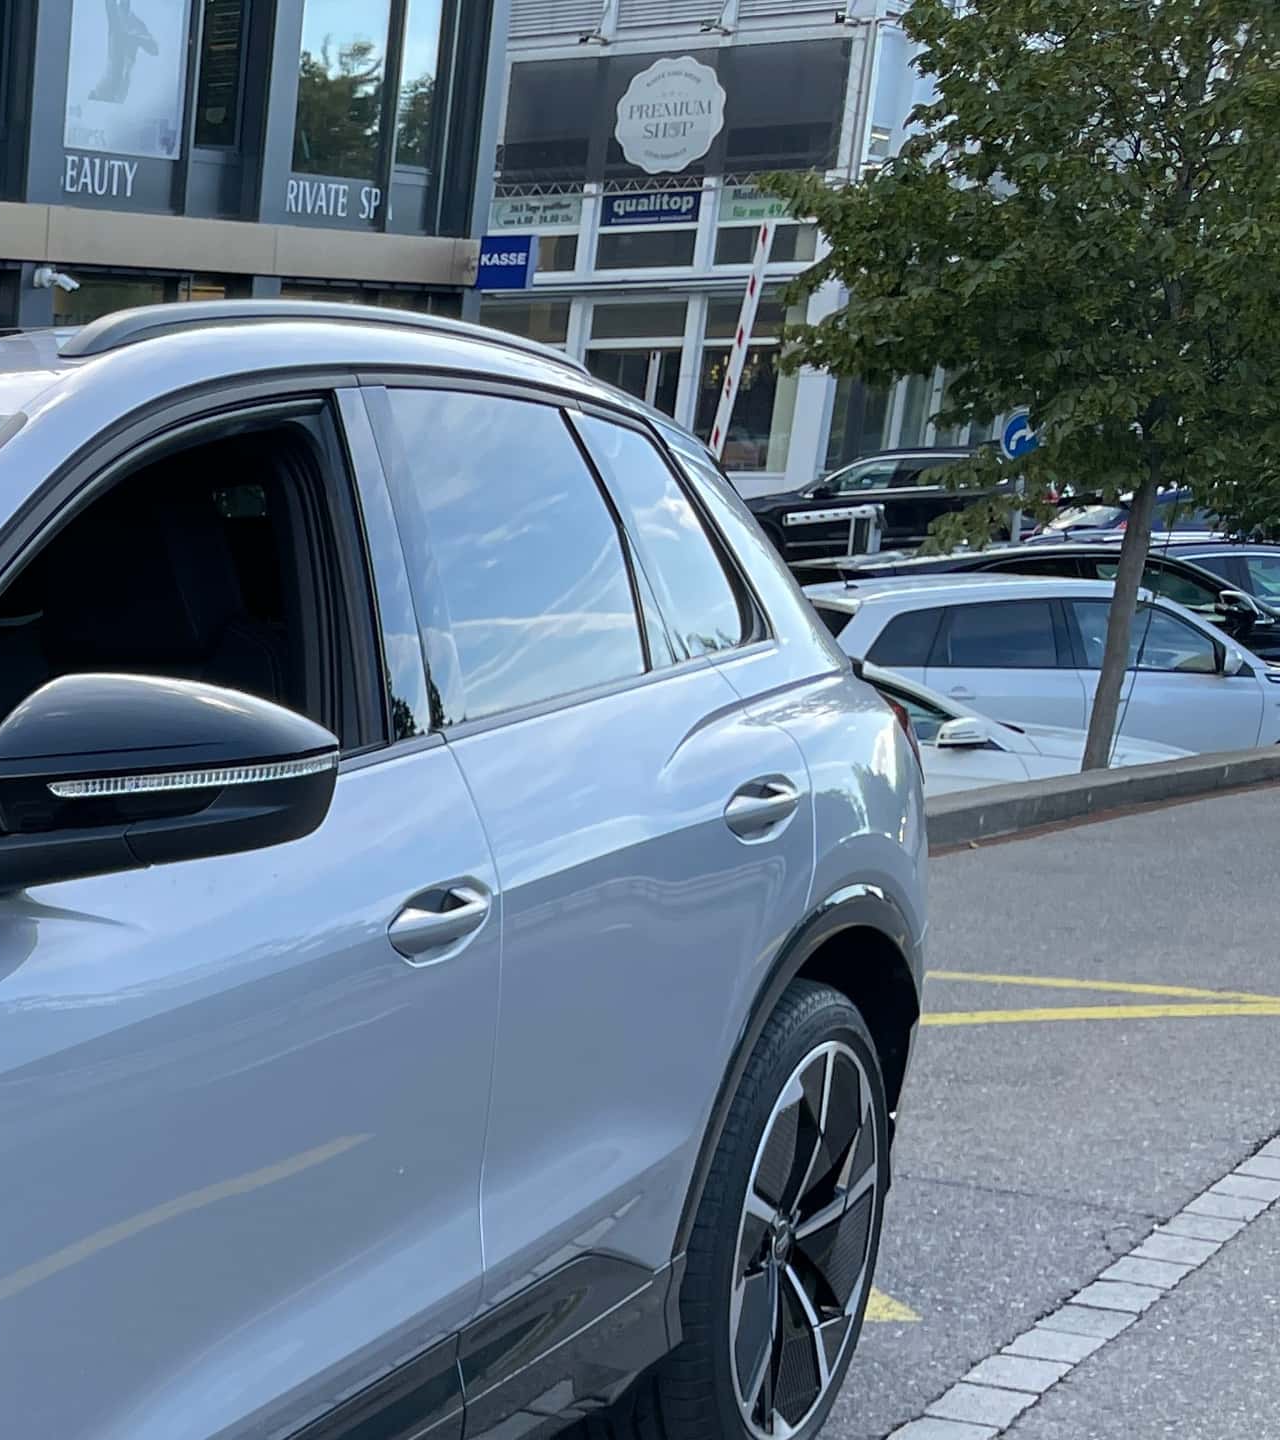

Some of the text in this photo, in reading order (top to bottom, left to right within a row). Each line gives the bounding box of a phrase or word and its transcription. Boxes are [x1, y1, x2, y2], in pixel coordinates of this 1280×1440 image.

[629, 100, 713, 120] PREMIUM
[642, 120, 695, 139] SHOP
[60, 155, 138, 198] EAUTY
[285, 179, 393, 221] RIVATE SP
[613, 193, 695, 216] qualitop
[480, 252, 528, 267] KASSE
